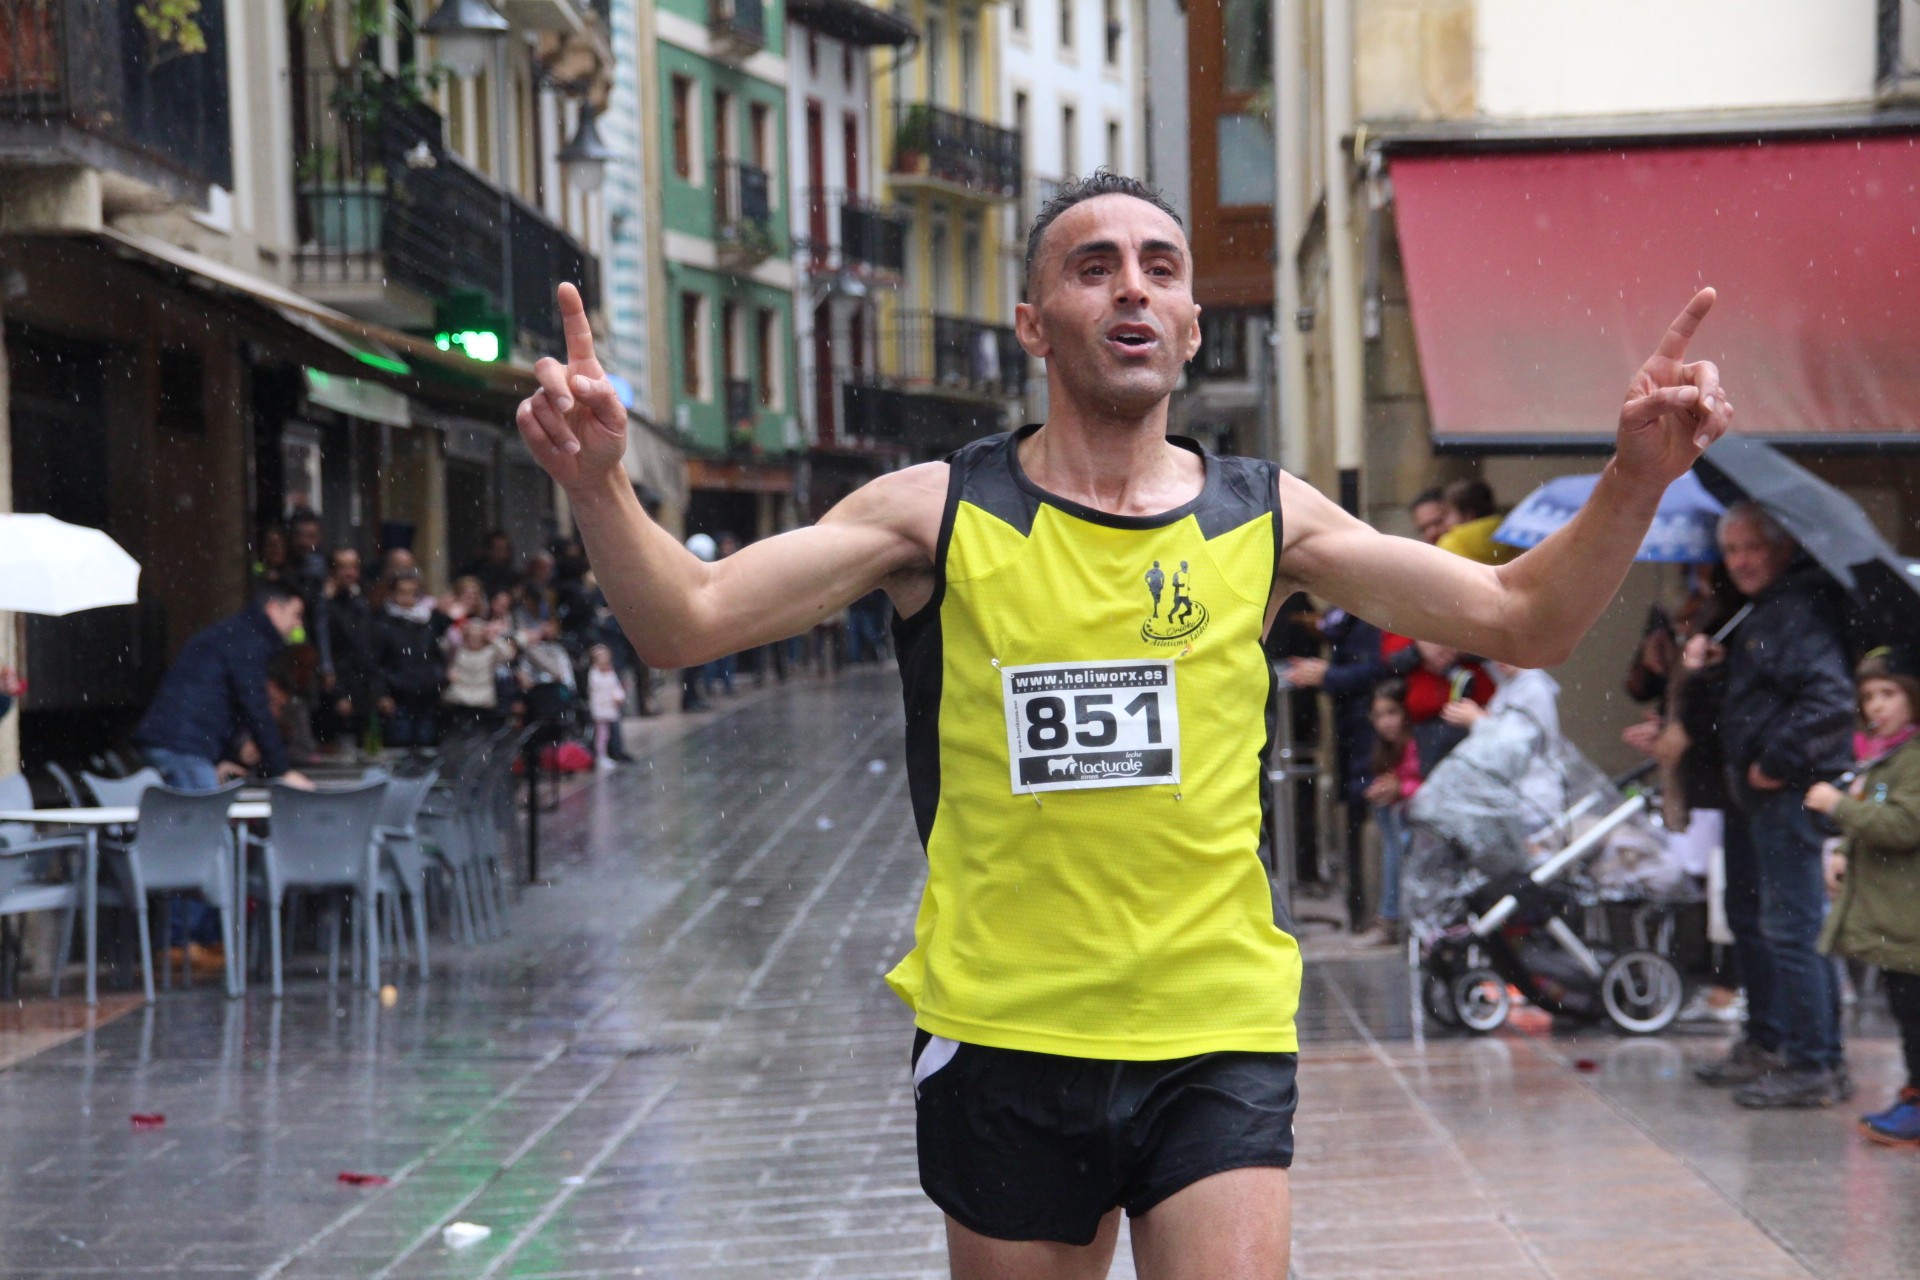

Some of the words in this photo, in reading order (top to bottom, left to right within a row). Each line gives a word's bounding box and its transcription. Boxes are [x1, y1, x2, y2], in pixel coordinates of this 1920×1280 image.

[1015, 670, 1164, 688] www.heliworx.es
[1026, 692, 1162, 750] 851
[1079, 758, 1143, 774] lacturale
